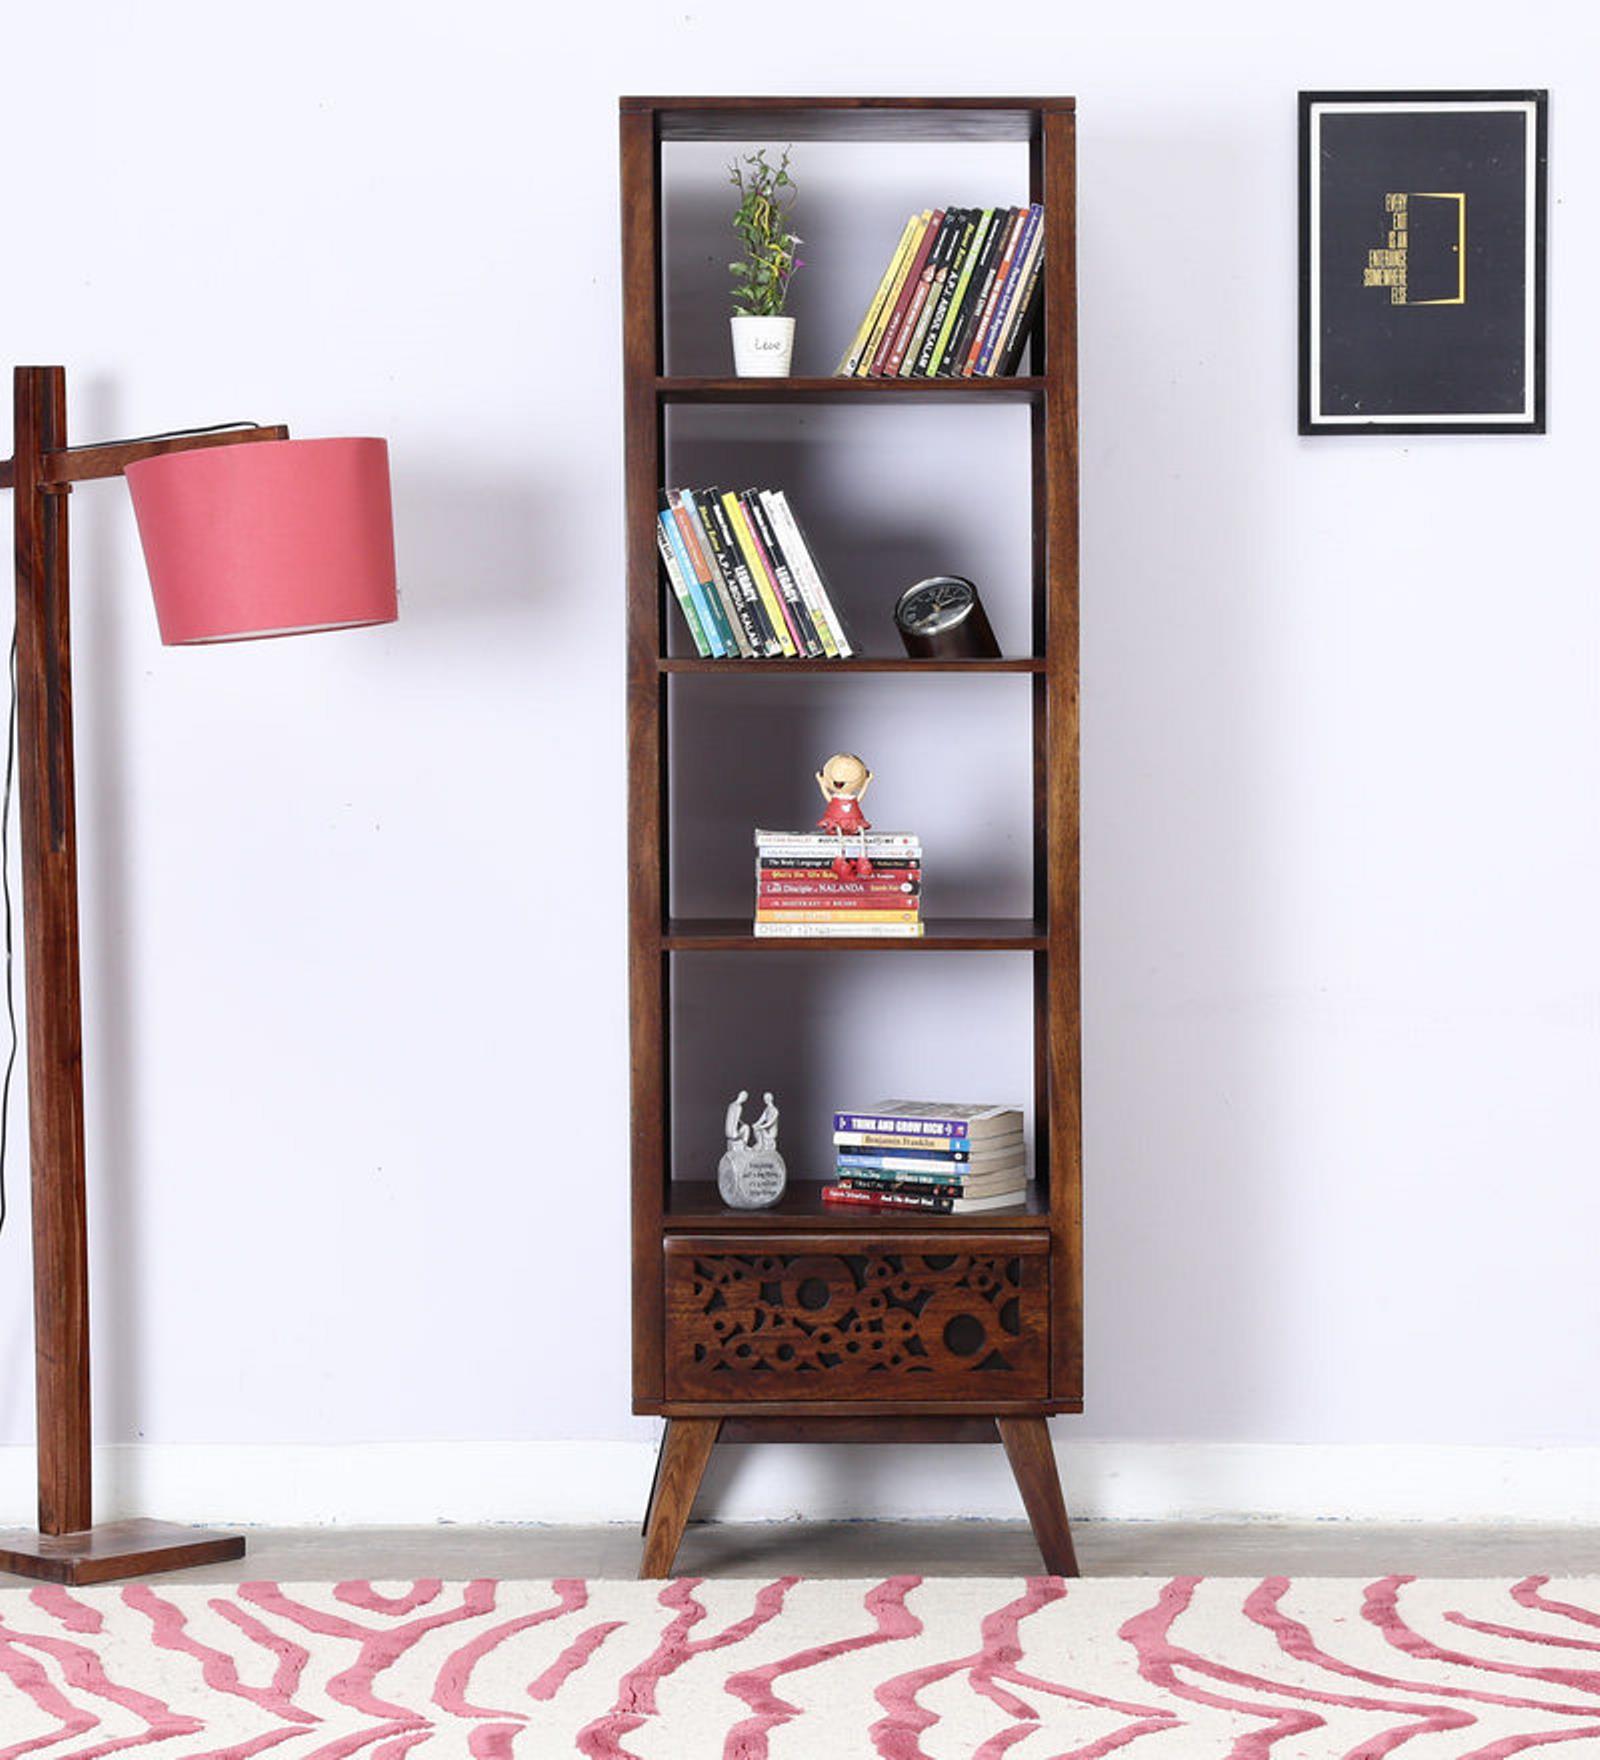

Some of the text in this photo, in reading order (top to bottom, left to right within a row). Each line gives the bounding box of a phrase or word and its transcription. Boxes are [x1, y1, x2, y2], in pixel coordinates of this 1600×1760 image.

[1385, 193, 1408, 212] EVERY
[1393, 212, 1408, 230] EXIT
[1364, 268, 1408, 287] SOMEWHERE
[1391, 286, 1408, 304] ELSE
[931, 297, 951, 332] ABDUL
[919, 333, 939, 369] KALAM
[734, 565, 758, 602] LEGACY
[775, 565, 800, 602] LEGACY
[740, 613, 760, 646] KALAM
[818, 881, 865, 893] NALANDA
[852, 1118, 944, 1134] THINK AND GROW RICH
[864, 1136, 935, 1147] Benjamin Franklin
